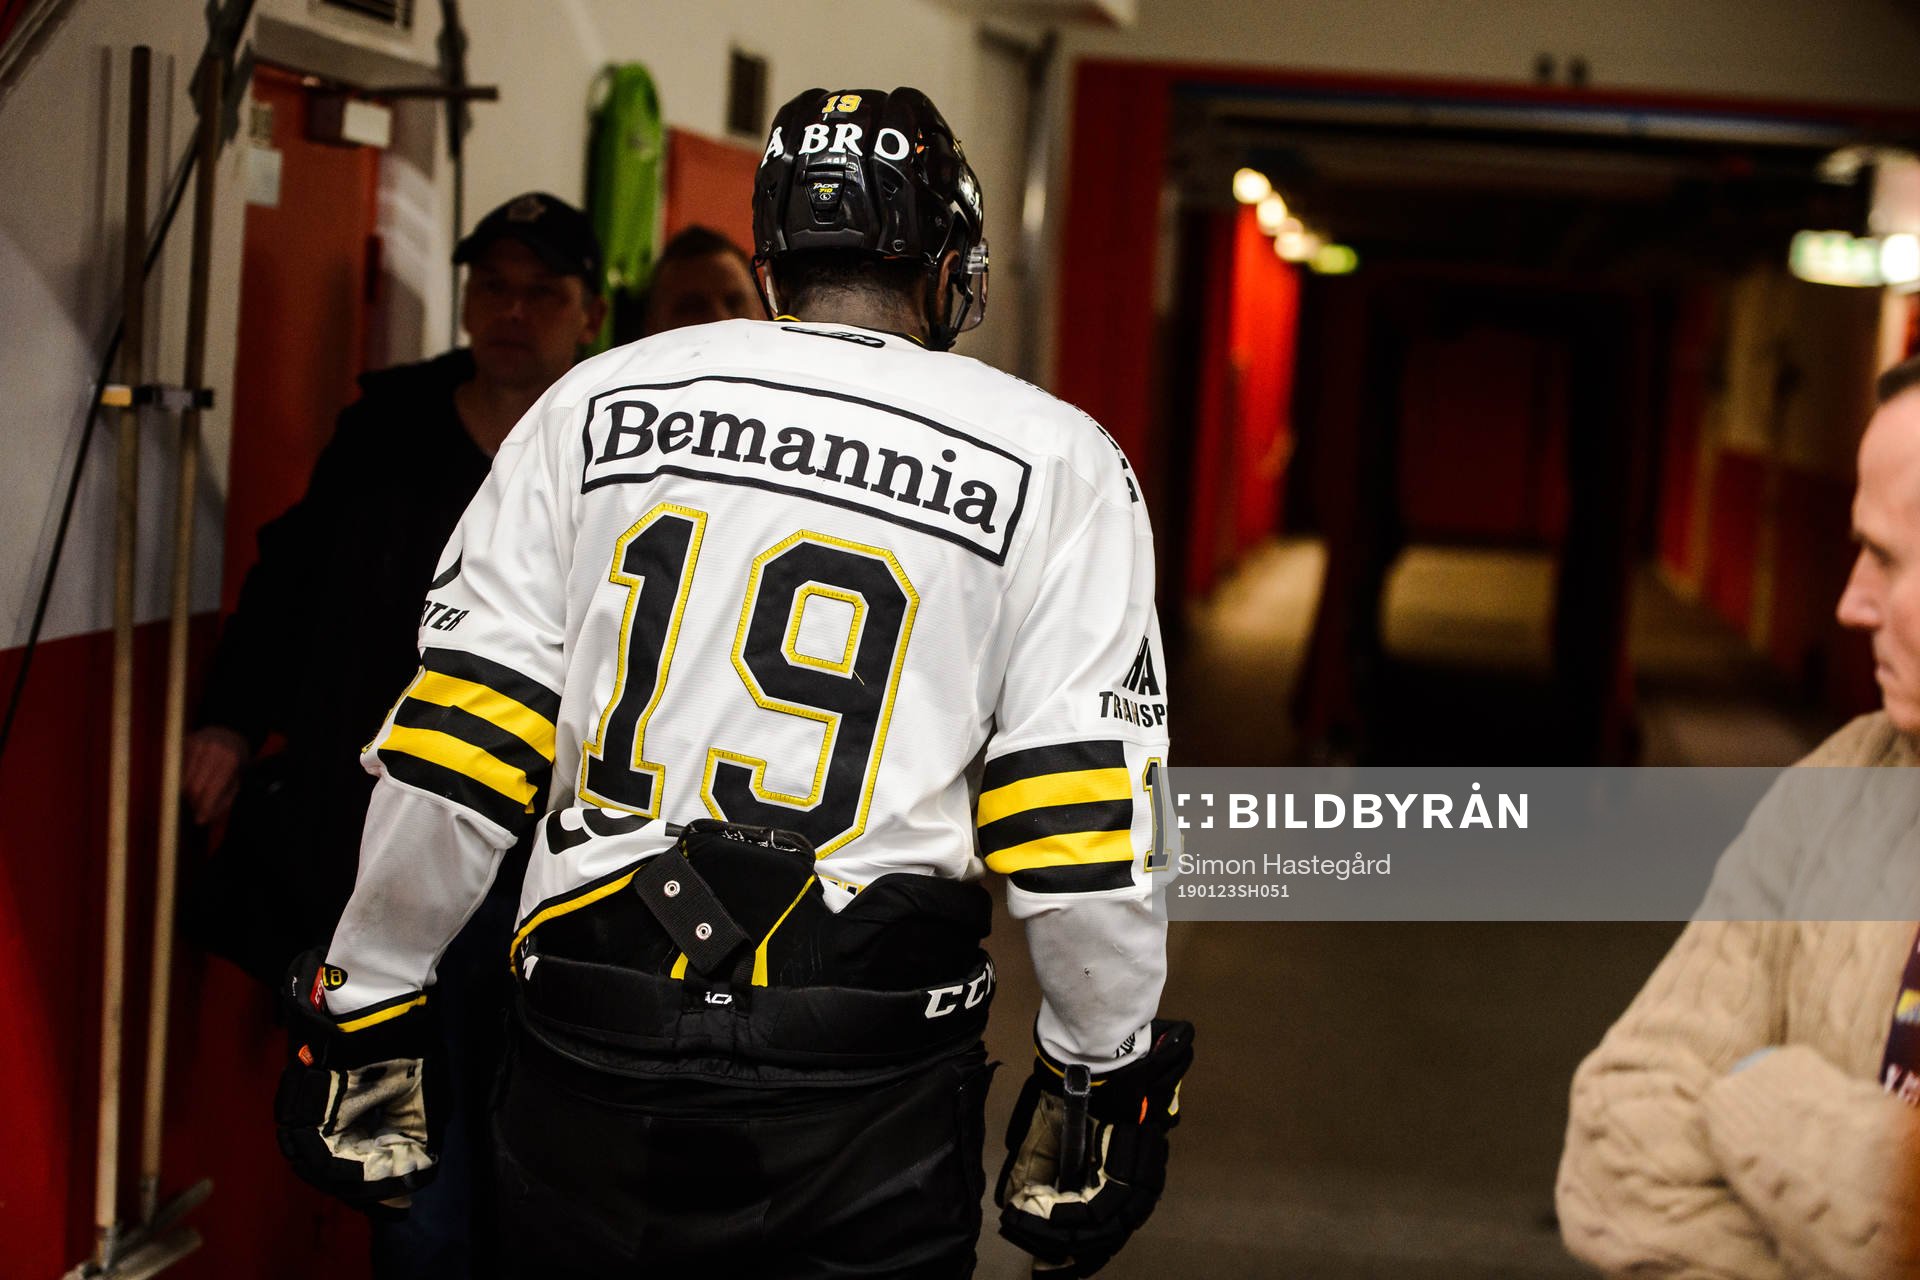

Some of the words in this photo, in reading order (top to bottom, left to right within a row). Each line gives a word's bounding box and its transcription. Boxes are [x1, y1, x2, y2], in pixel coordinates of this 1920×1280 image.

[821, 94, 863, 114] 19
[595, 400, 997, 534] Bemannia
[578, 503, 920, 861] 19
[1099, 691, 1168, 728] TRANSP
[1142, 757, 1184, 873] 1
